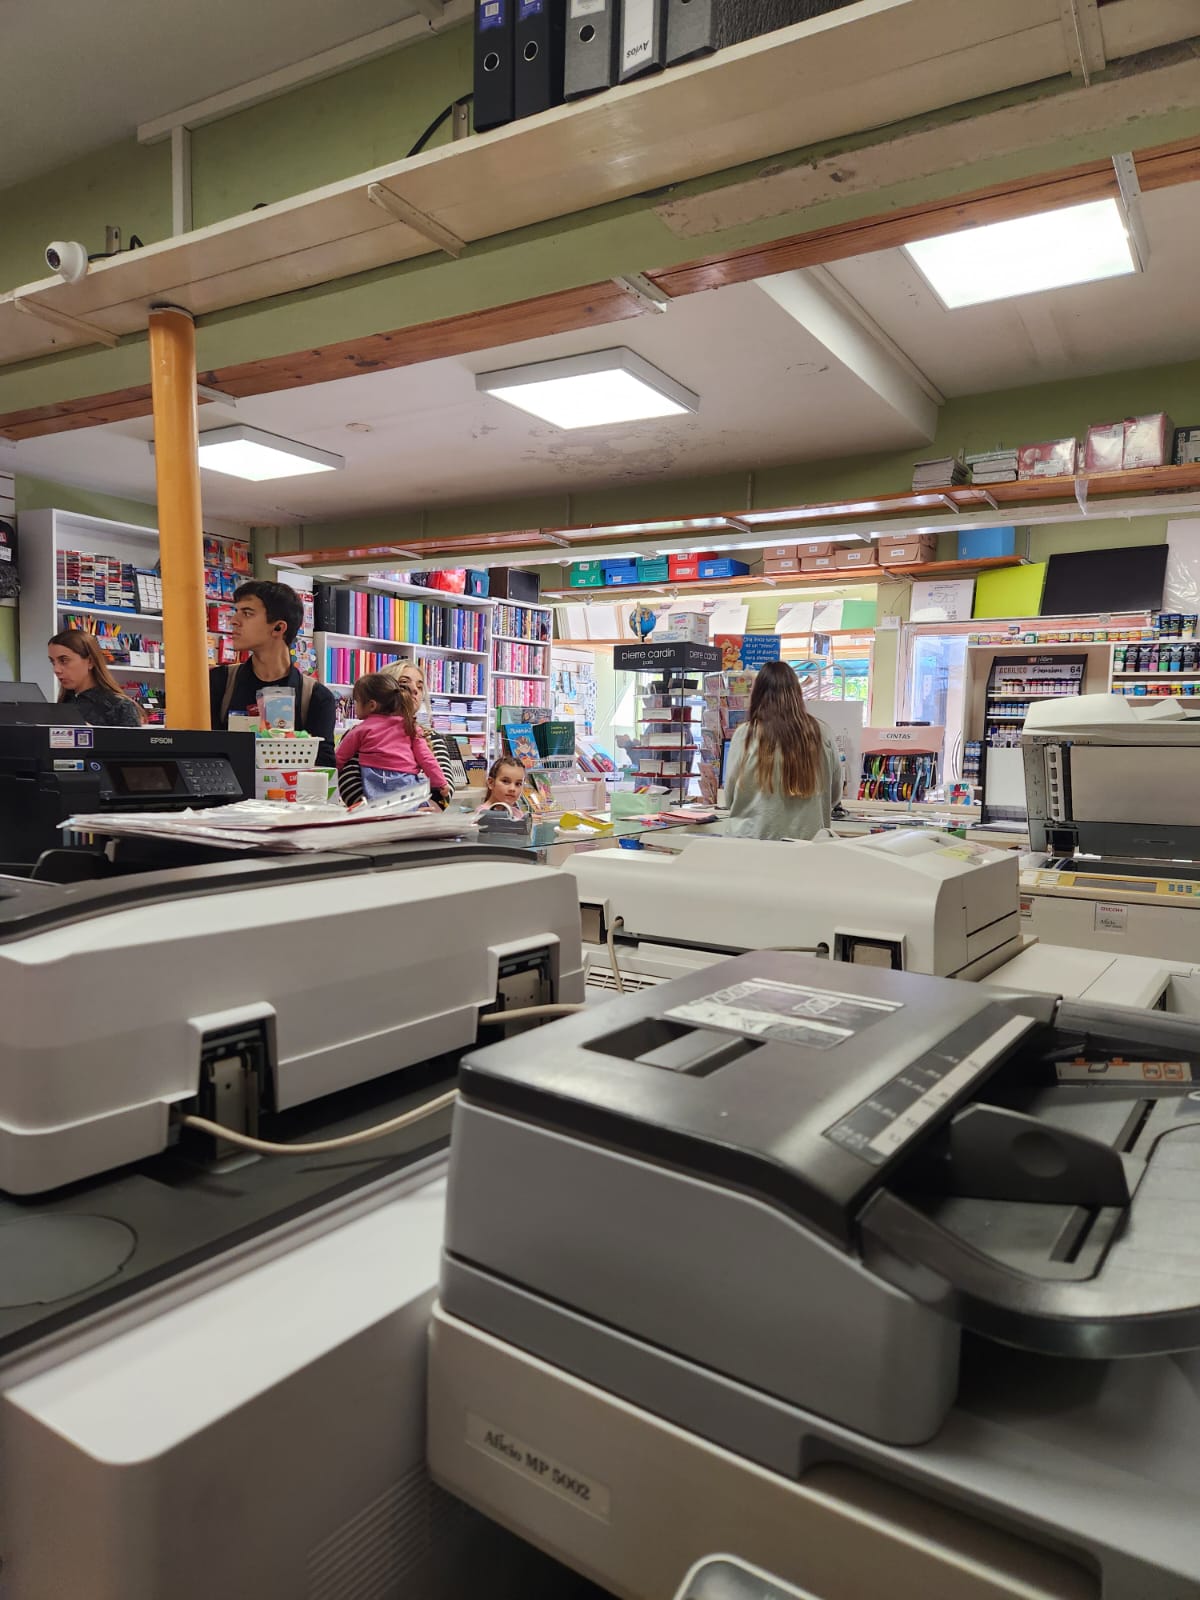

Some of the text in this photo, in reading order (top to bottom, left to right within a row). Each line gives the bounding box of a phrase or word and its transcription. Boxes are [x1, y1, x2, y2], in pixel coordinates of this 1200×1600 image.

[621, 648, 676, 660] pierre cardin
[1070, 665, 1081, 674] 64
[525, 1453, 549, 1476] MP
